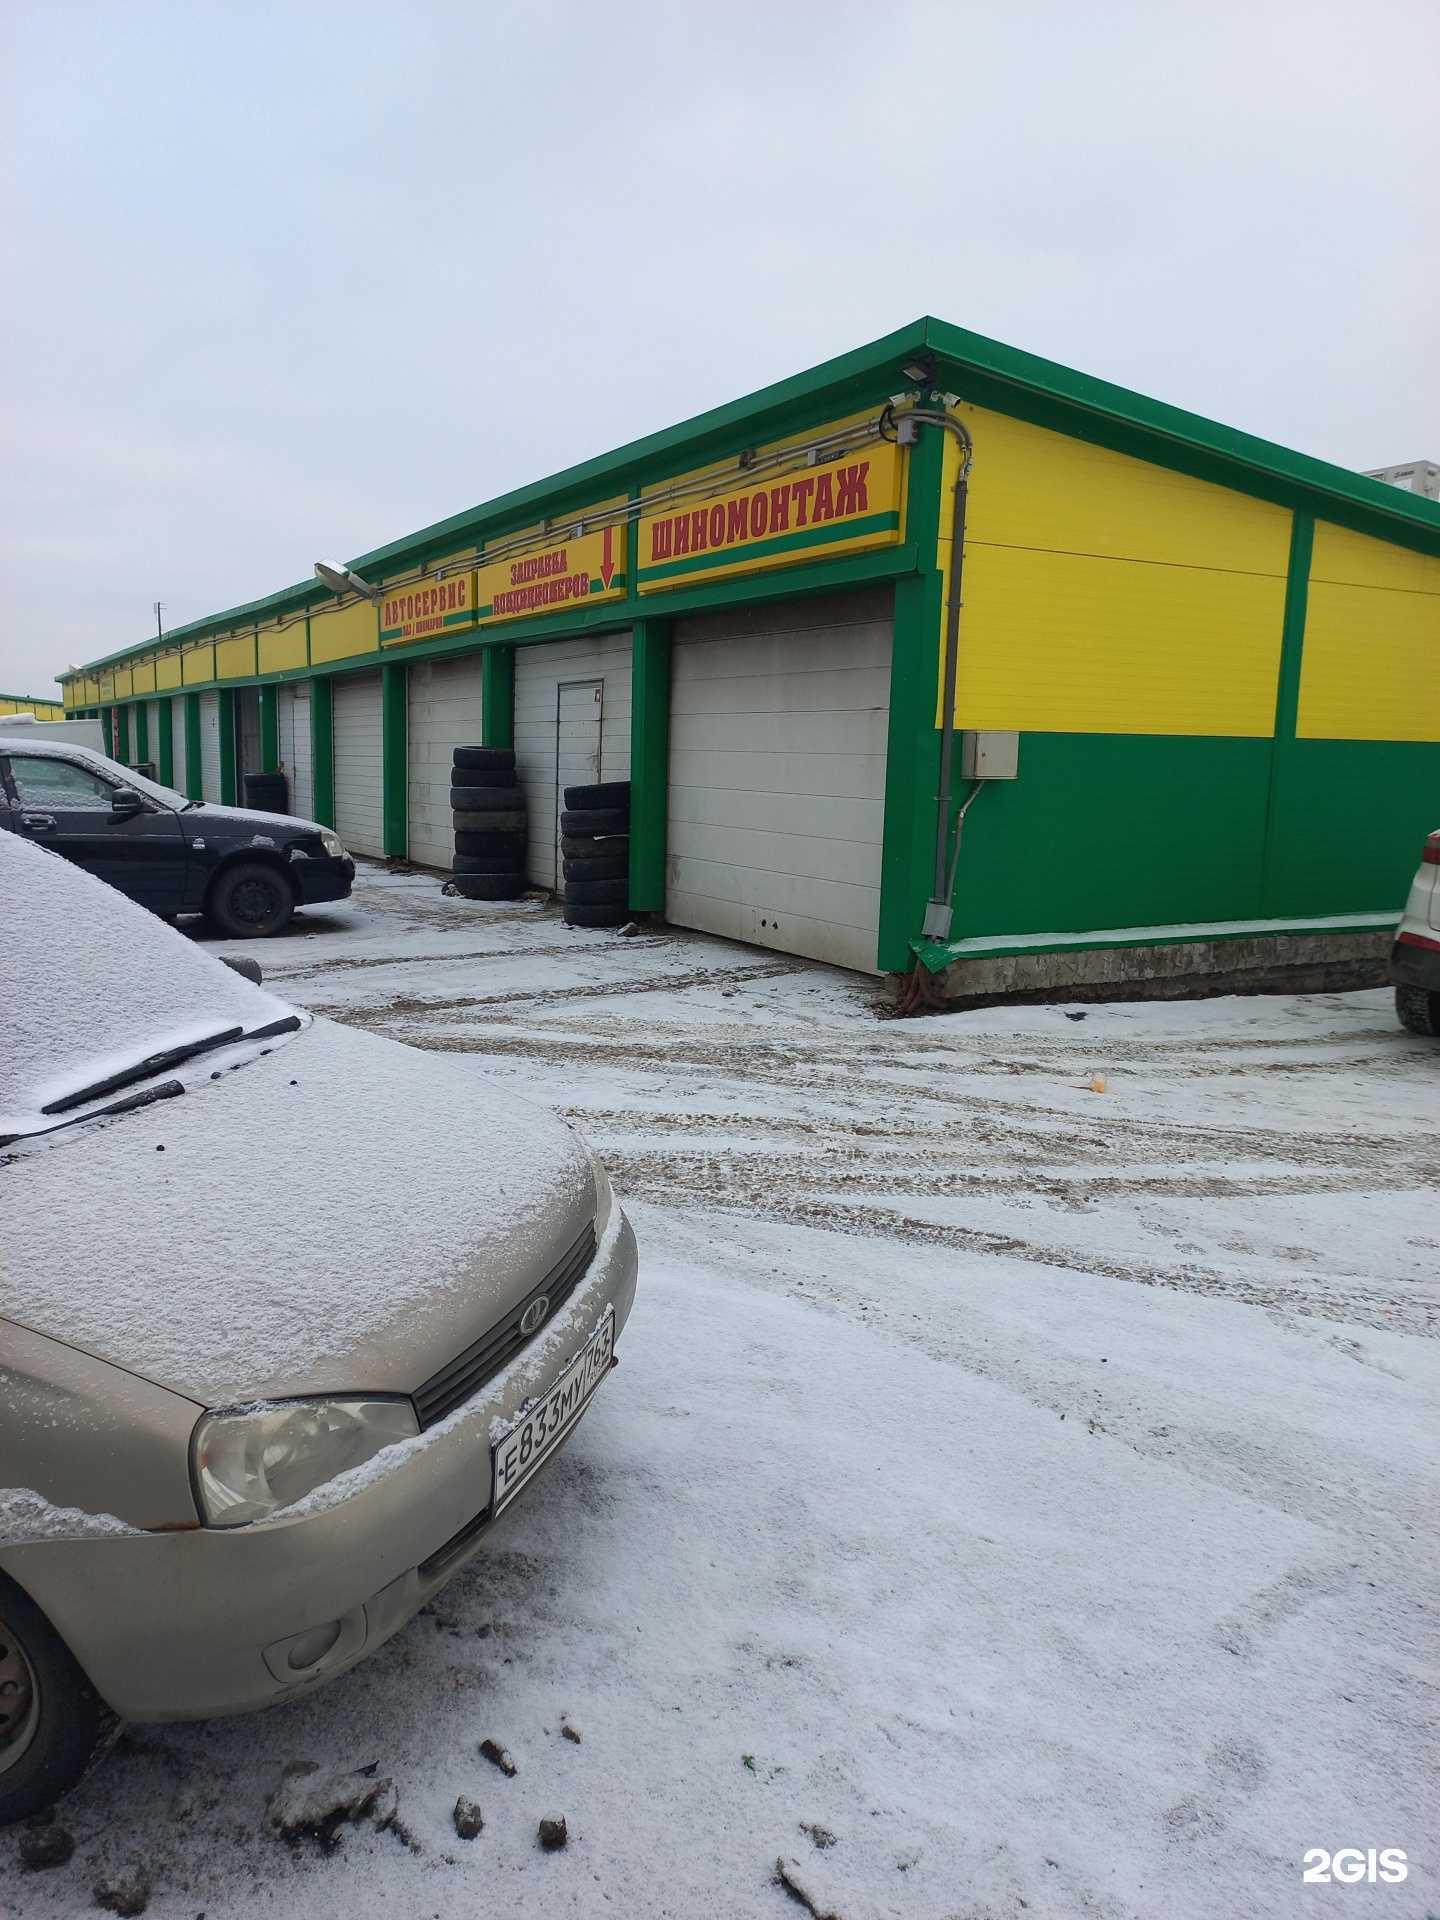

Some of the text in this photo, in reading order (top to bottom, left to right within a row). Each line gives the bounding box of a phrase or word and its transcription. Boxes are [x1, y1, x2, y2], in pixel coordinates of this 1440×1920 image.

[651, 461, 870, 561] ШИНОМОНТАЖ
[511, 549, 567, 585] ЗАПРАВКА
[385, 580, 465, 626] АВТОСЕРВИС
[494, 572, 589, 615] КОНДИЦИОНЕРОВ
